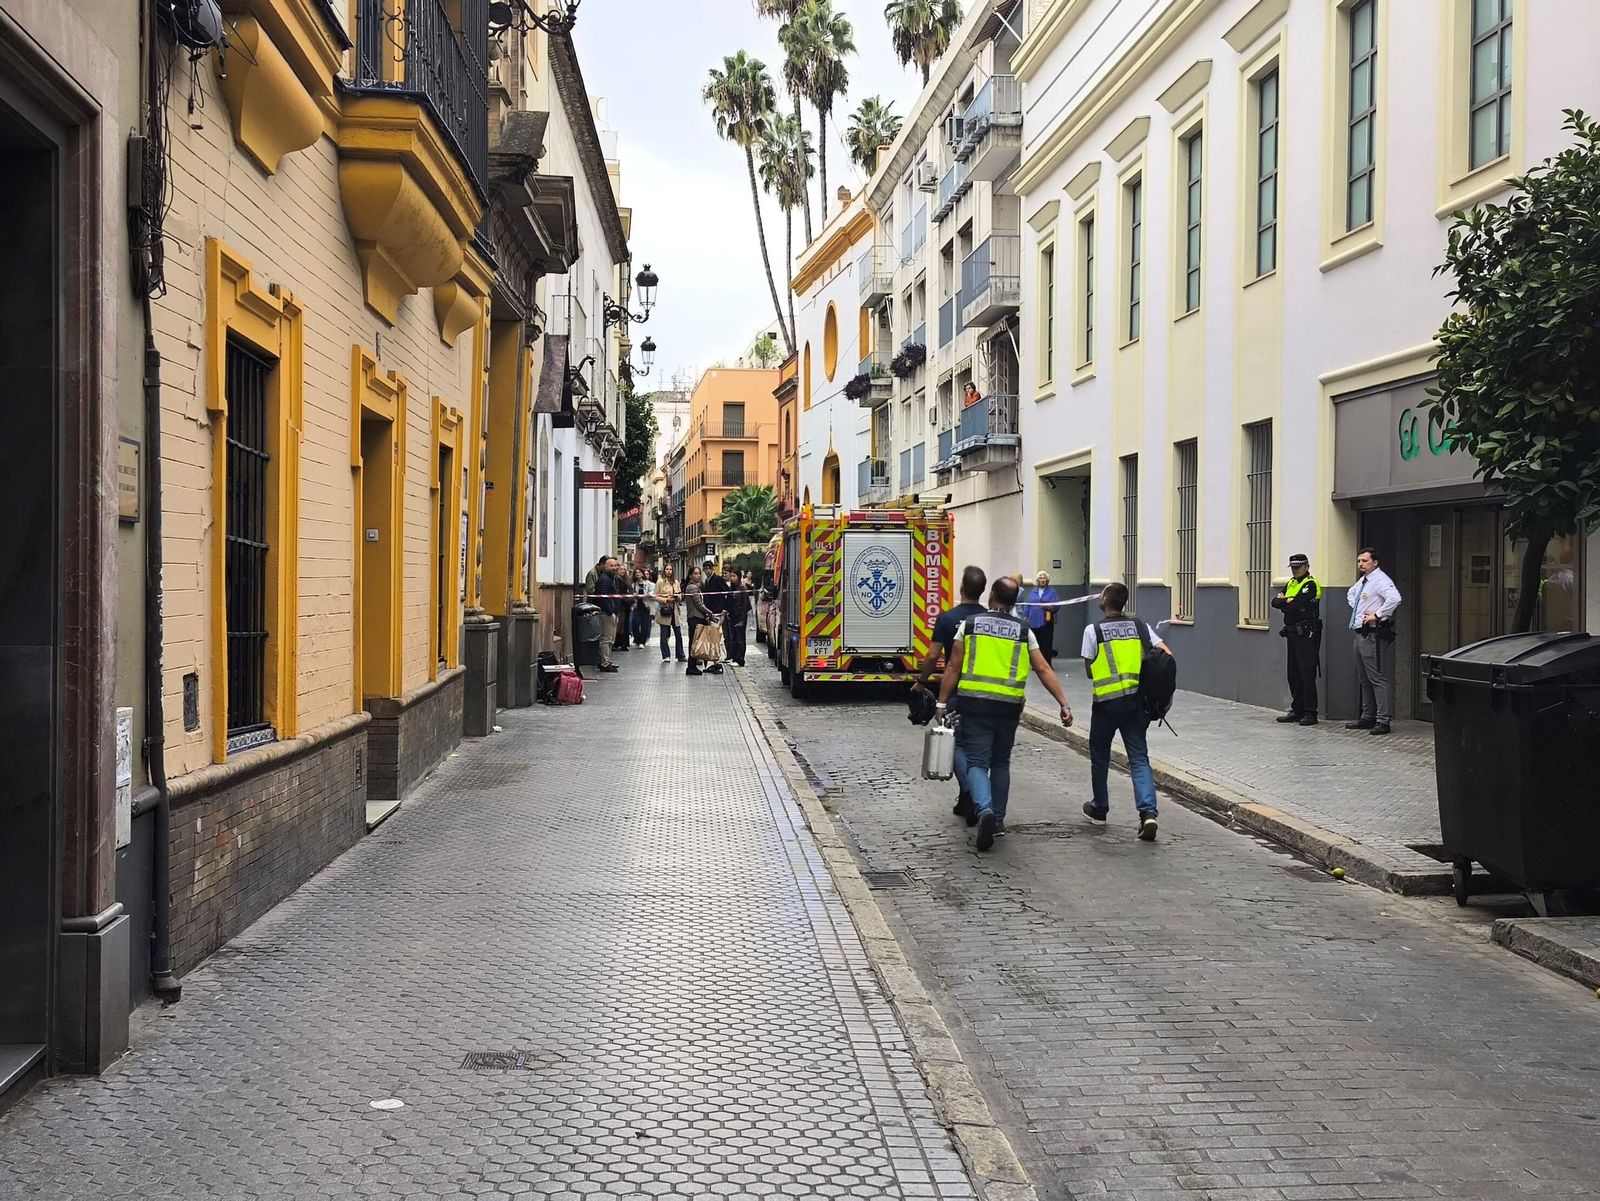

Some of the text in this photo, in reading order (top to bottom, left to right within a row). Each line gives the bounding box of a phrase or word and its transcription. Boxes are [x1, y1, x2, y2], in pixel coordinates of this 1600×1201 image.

[926, 529, 940, 628] BOMBEROS
[975, 622, 1018, 638] POLICIA
[1103, 627, 1138, 639] POLICI
[813, 639, 831, 647] 5370
[814, 647, 828, 655] KFT
